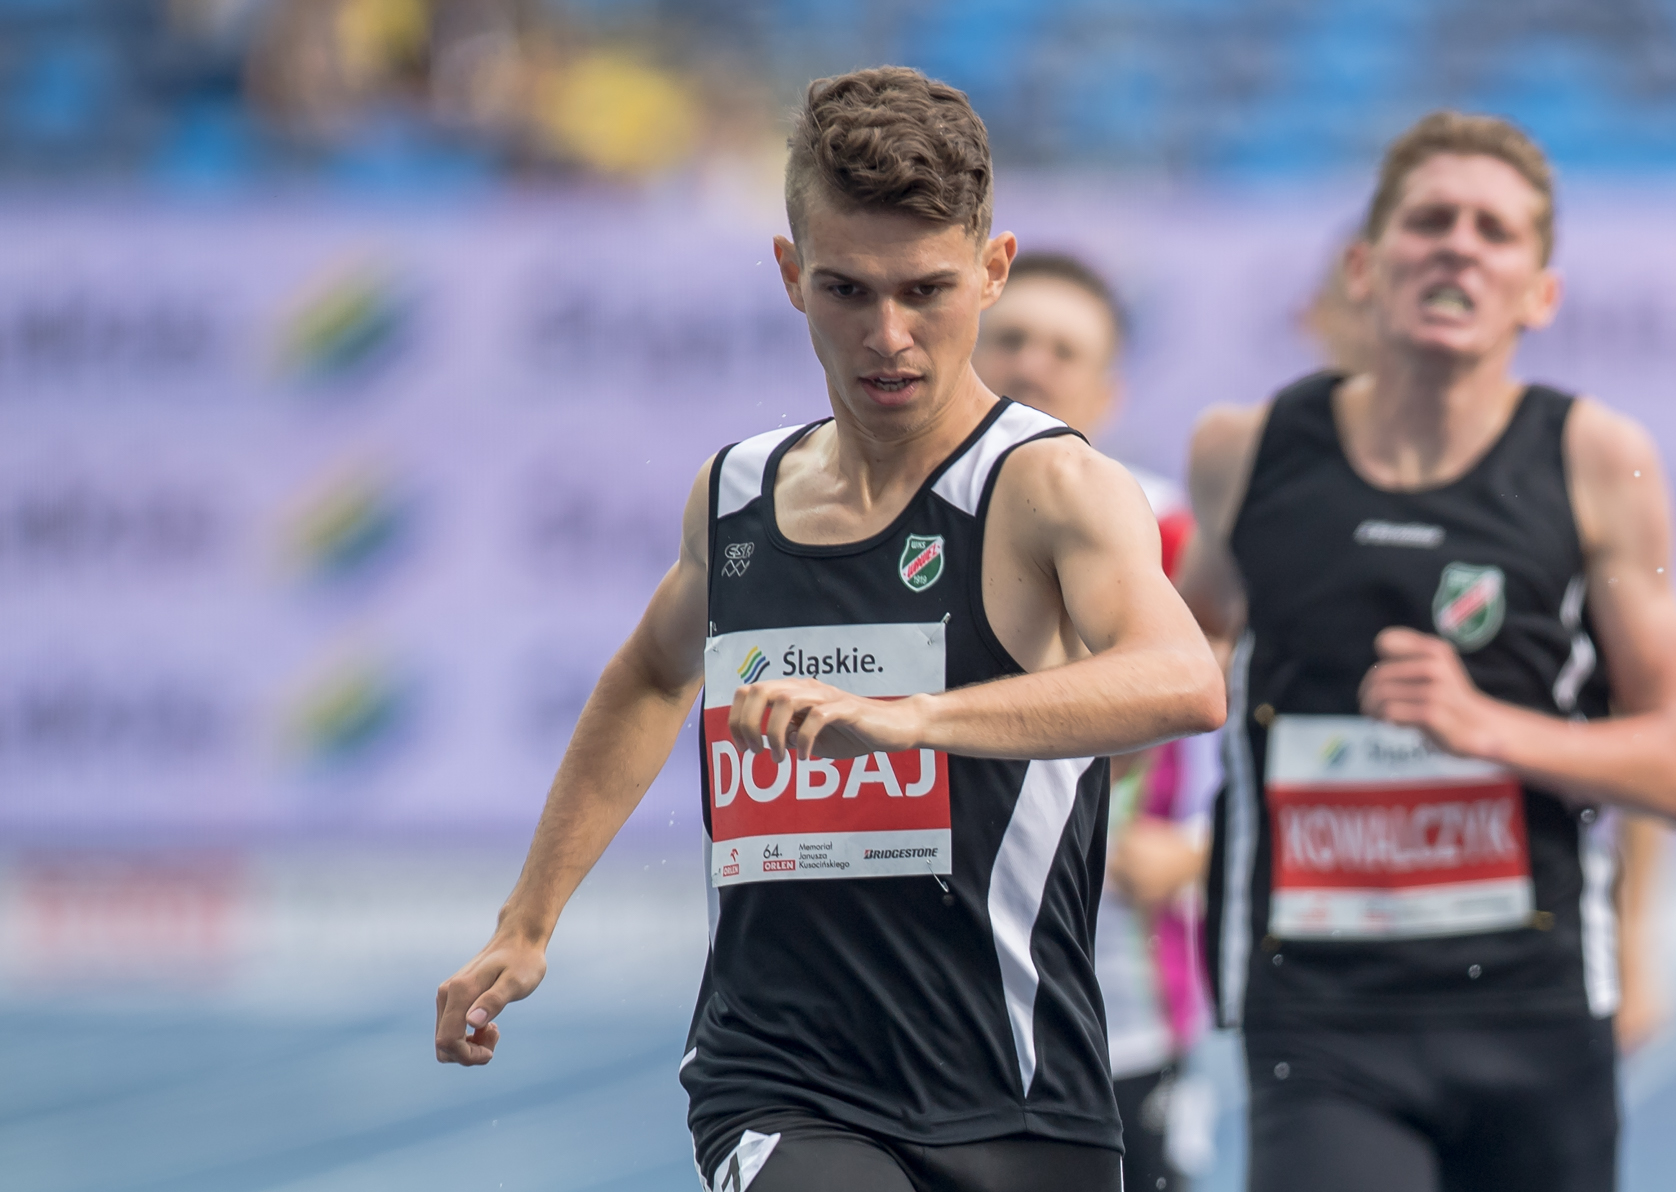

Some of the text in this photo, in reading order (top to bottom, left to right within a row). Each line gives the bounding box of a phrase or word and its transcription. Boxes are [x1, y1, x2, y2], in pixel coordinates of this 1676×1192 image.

[782, 645, 884, 679] Śląskie.
[711, 735, 936, 807] DOBAJ
[1281, 799, 1518, 872] KOWALCZYK
[763, 841, 833, 859] 64. Memoriał
[799, 852, 828, 860] Janusza
[863, 848, 938, 859] BRIDGESTONE
[723, 864, 739, 876] ORLEN
[764, 861, 794, 871] ORLEN
[799, 860, 850, 870] Kusocińskiego
